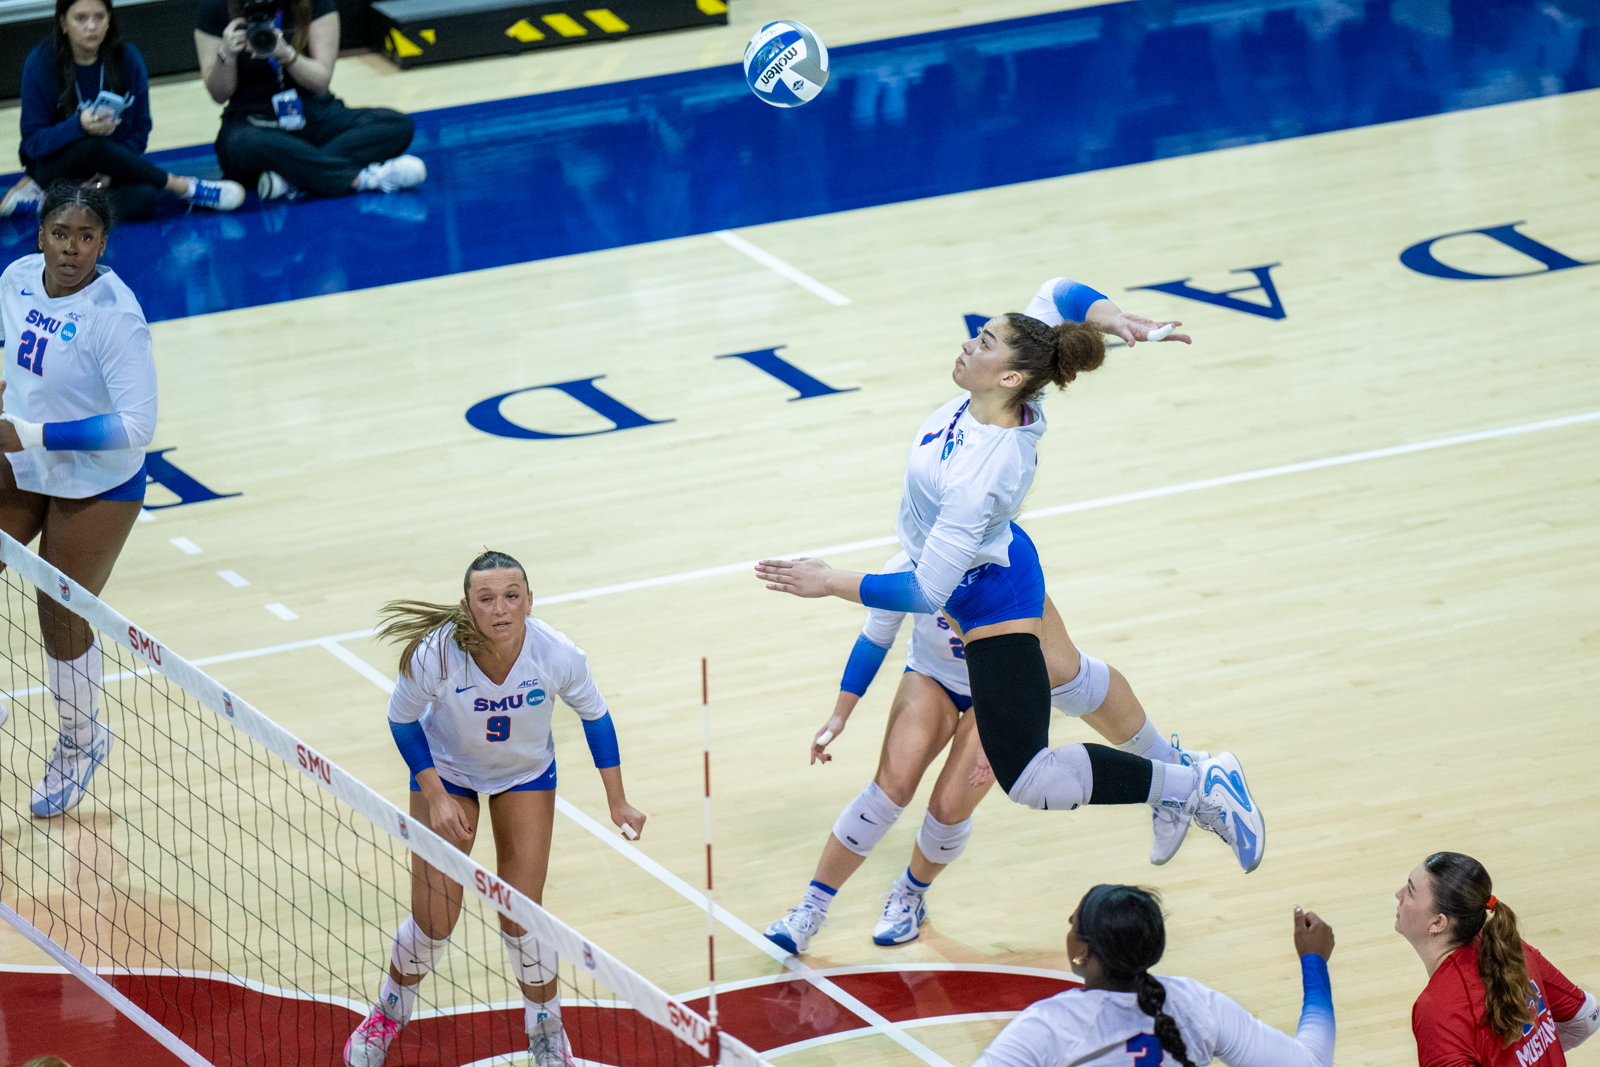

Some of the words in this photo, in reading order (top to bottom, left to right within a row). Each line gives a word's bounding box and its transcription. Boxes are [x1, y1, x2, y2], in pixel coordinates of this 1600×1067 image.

[760, 46, 798, 85] molten
[25, 309, 62, 334] SMU
[66, 311, 82, 321] ACC
[17, 329, 49, 377] 21
[127, 624, 163, 666] SMU
[473, 693, 524, 712] SMU
[517, 678, 539, 689] ACC
[486, 715, 512, 743] 9
[296, 743, 332, 786] SMU
[473, 869, 512, 912] SMU
[1515, 1010, 1557, 1067] MUSTAN
